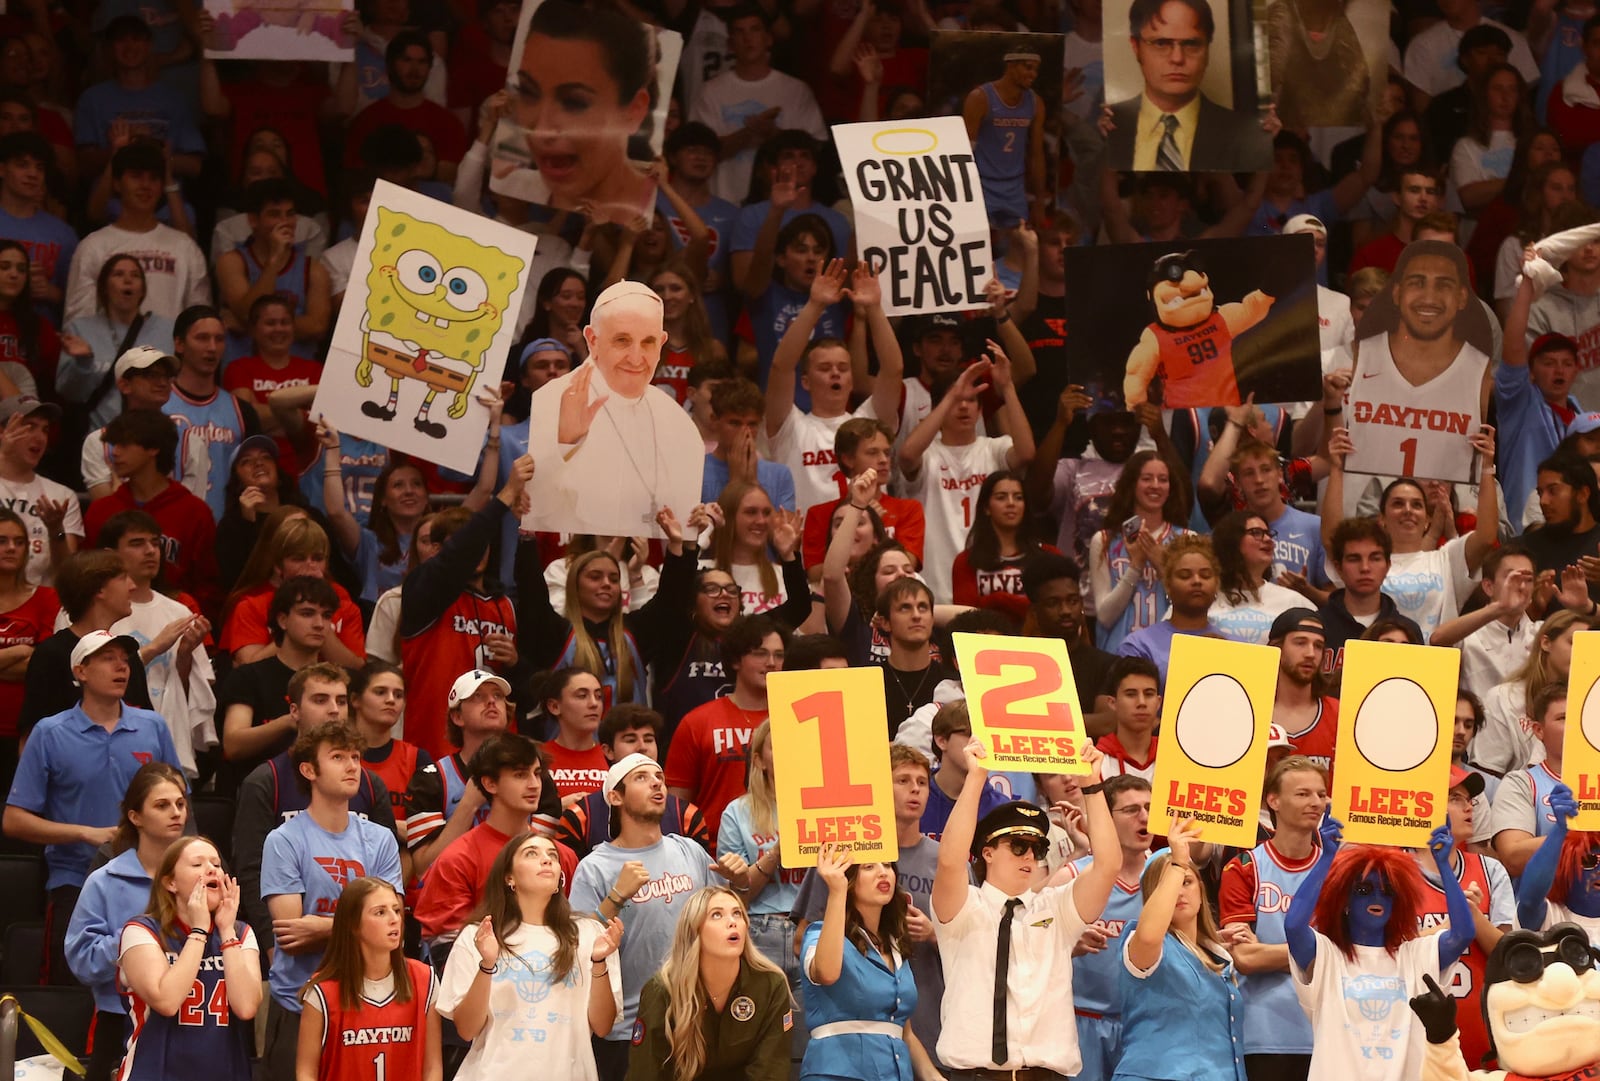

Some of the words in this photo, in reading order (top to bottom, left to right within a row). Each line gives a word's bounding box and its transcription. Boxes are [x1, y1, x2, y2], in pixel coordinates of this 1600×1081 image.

[1004, 131, 1015, 152] 2
[856, 155, 973, 202] GRANT
[898, 203, 955, 247] US
[863, 241, 988, 309] PEACE
[1187, 338, 1219, 365] 99
[1354, 401, 1472, 436] DAYTON
[1399, 437, 1418, 478] 1
[961, 497, 971, 528] 1
[1131, 591, 1158, 632] 11
[975, 649, 1076, 735] 2
[713, 727, 753, 755] FIV
[791, 690, 874, 810] 1
[991, 735, 1076, 757] LEE'S
[994, 754, 1022, 762] Famous
[1023, 755, 1047, 764] Recipe
[1049, 756, 1078, 765] Chicken
[555, 781, 602, 789] BASKETBALL
[1168, 780, 1247, 817] LEE'S
[1349, 786, 1434, 818] LEE'S
[1577, 801, 1600, 812] Famou
[797, 814, 882, 844] LEE'S
[1216, 813, 1244, 828] Chicken
[1348, 812, 1377, 825] Famous
[1377, 815, 1403, 827] Recipe
[1403, 817, 1432, 829] Chicken
[798, 844, 828, 855] Famo
[853, 840, 883, 852] Chicken
[632, 871, 694, 904] Dayton
[178, 978, 229, 1027] 24
[342, 1026, 414, 1046] DAYTON
[373, 1053, 386, 1081] 1
